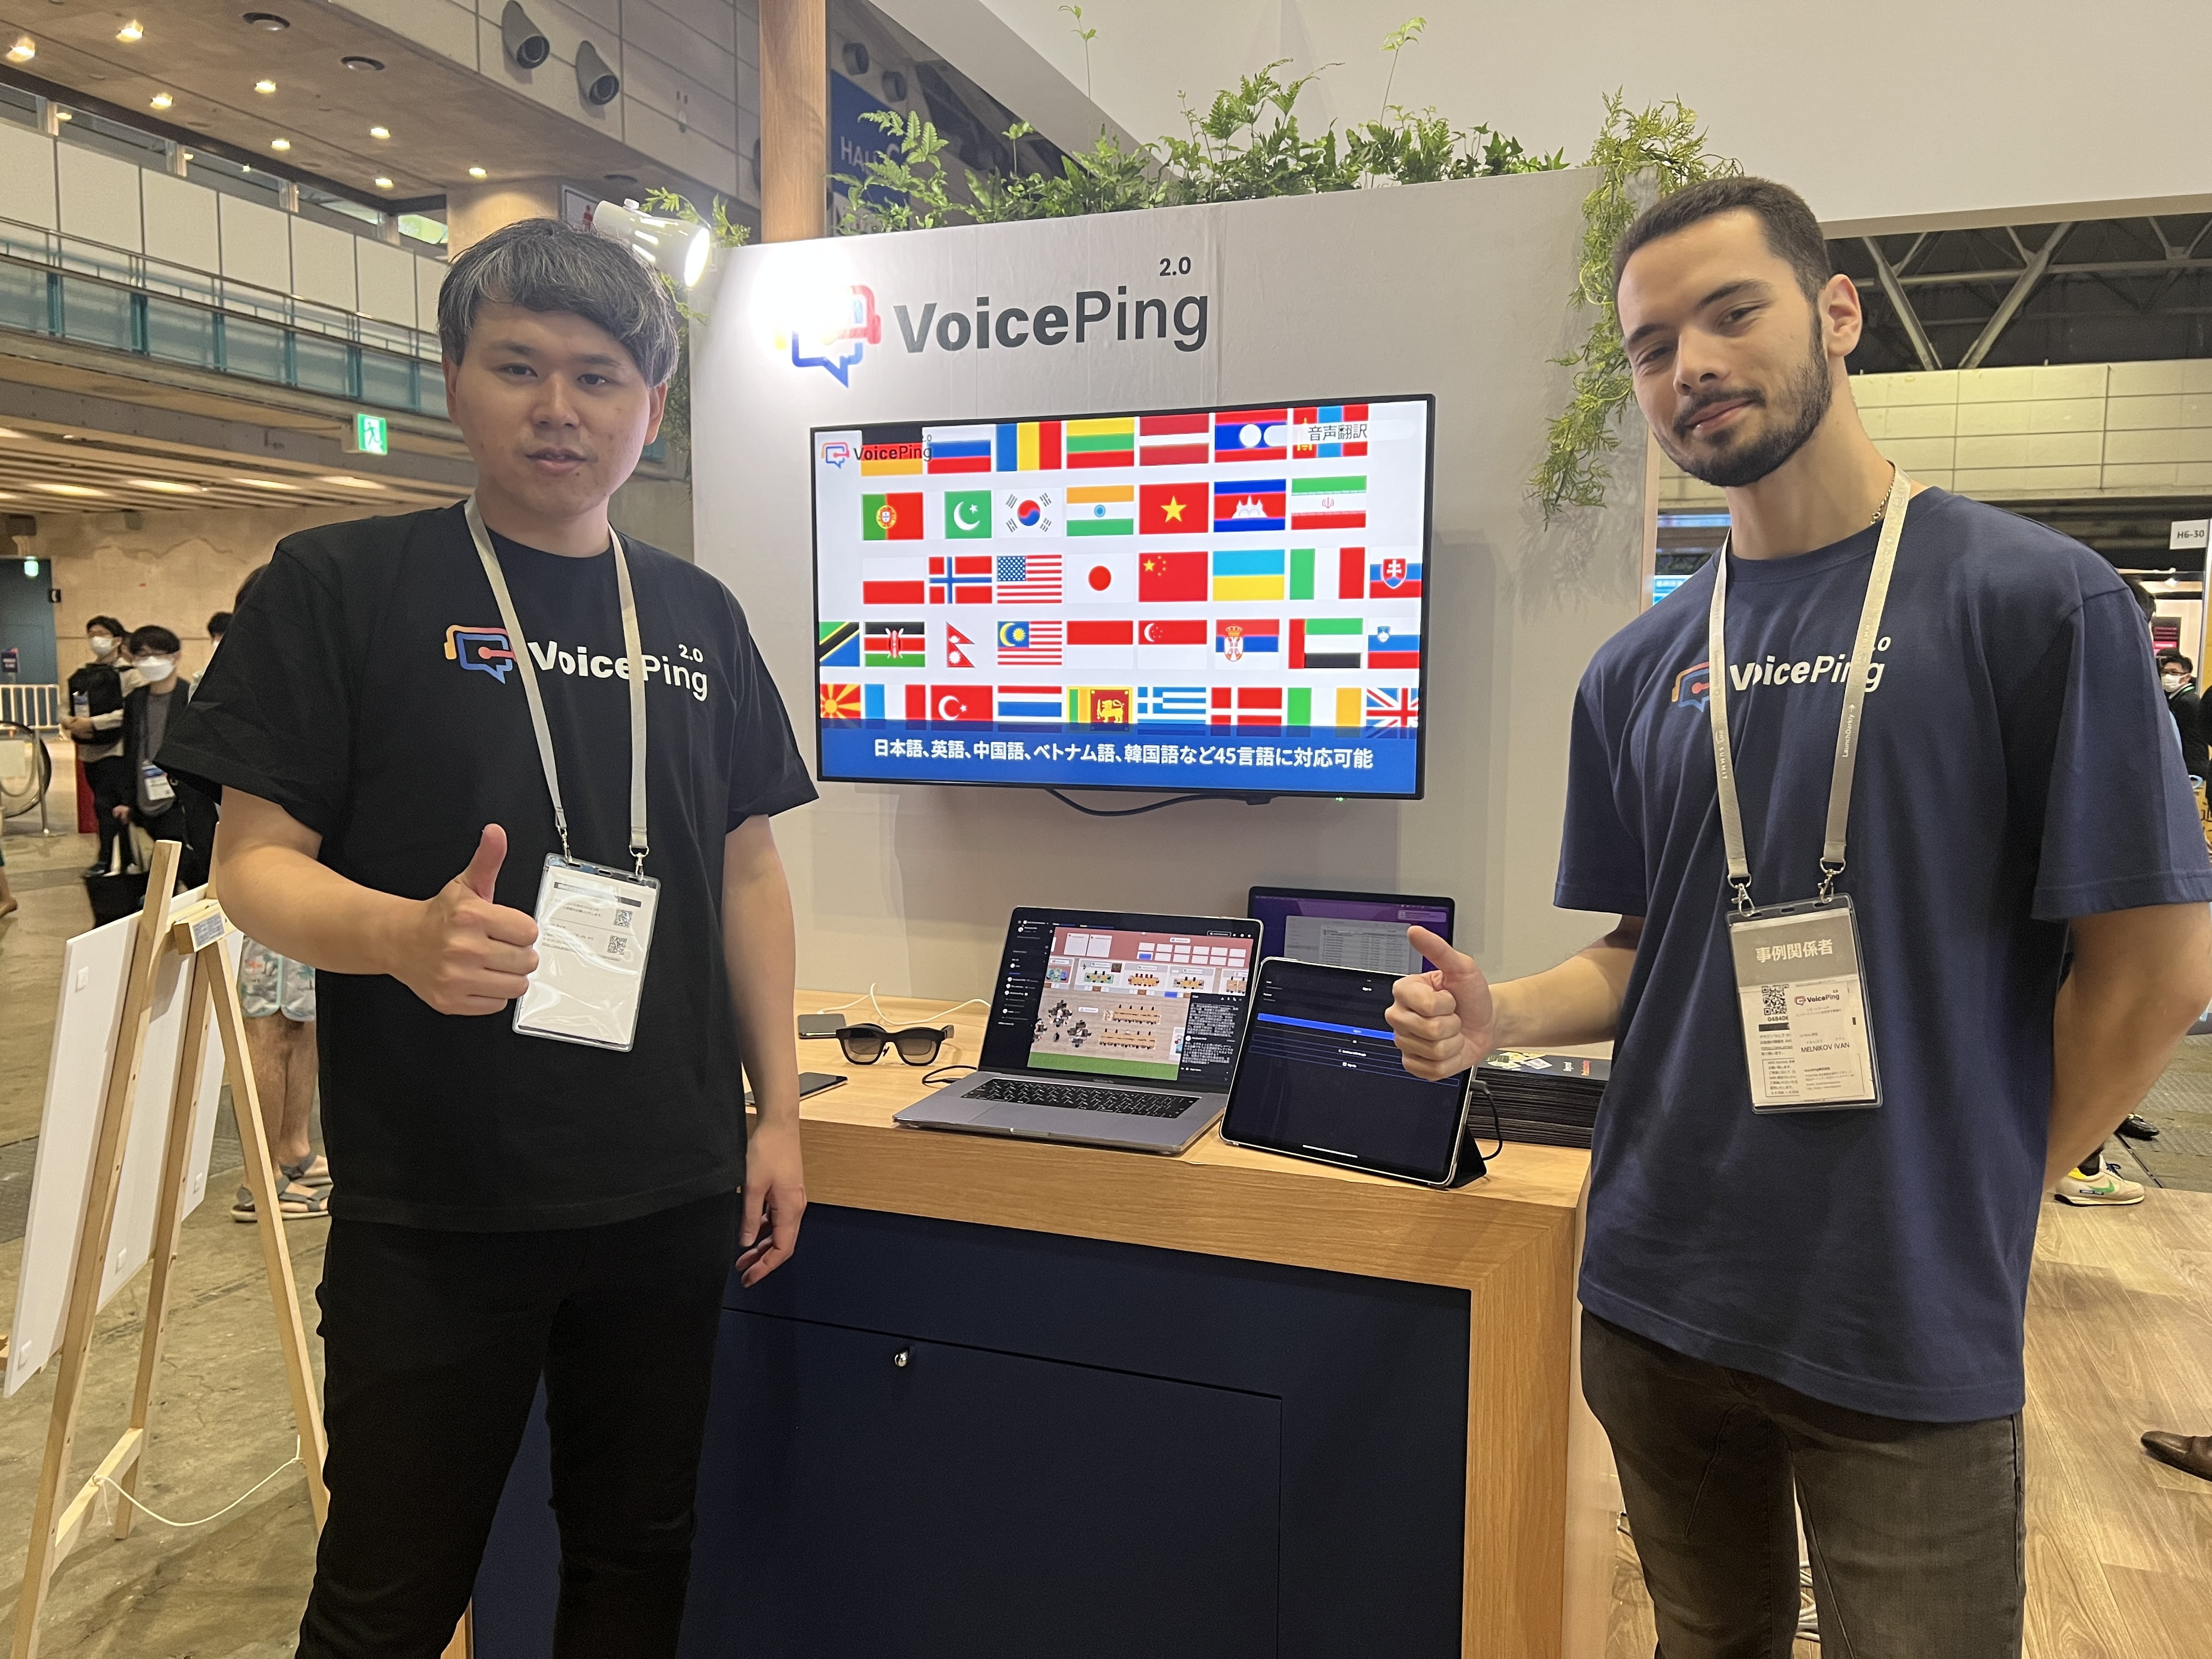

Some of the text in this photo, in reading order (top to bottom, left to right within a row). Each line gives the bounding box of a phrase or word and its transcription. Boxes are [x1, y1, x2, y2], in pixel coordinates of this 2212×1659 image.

[1159, 256, 1192, 276] 2.0
[893, 285, 1208, 353] VoicePing
[1308, 423, 1368, 442] 音声翻訳
[853, 444, 933, 462] VoicePing
[2177, 529, 2205, 539] H6-30
[678, 644, 704, 663] 2.0
[527, 640, 708, 702] VoicePing
[1842, 714, 1855, 758] LaunchDarkly
[874, 738, 1374, 769] 日本語、英語、中国語、ベトナム語、韓国語など45言語に対応可能
[1716, 729, 1728, 779] aws SUMMIT
[1756, 939, 1833, 963] 事例関係者
[1807, 994, 1840, 1003] VoicePing
[1801, 1044, 1832, 1053] MELNIKOV
